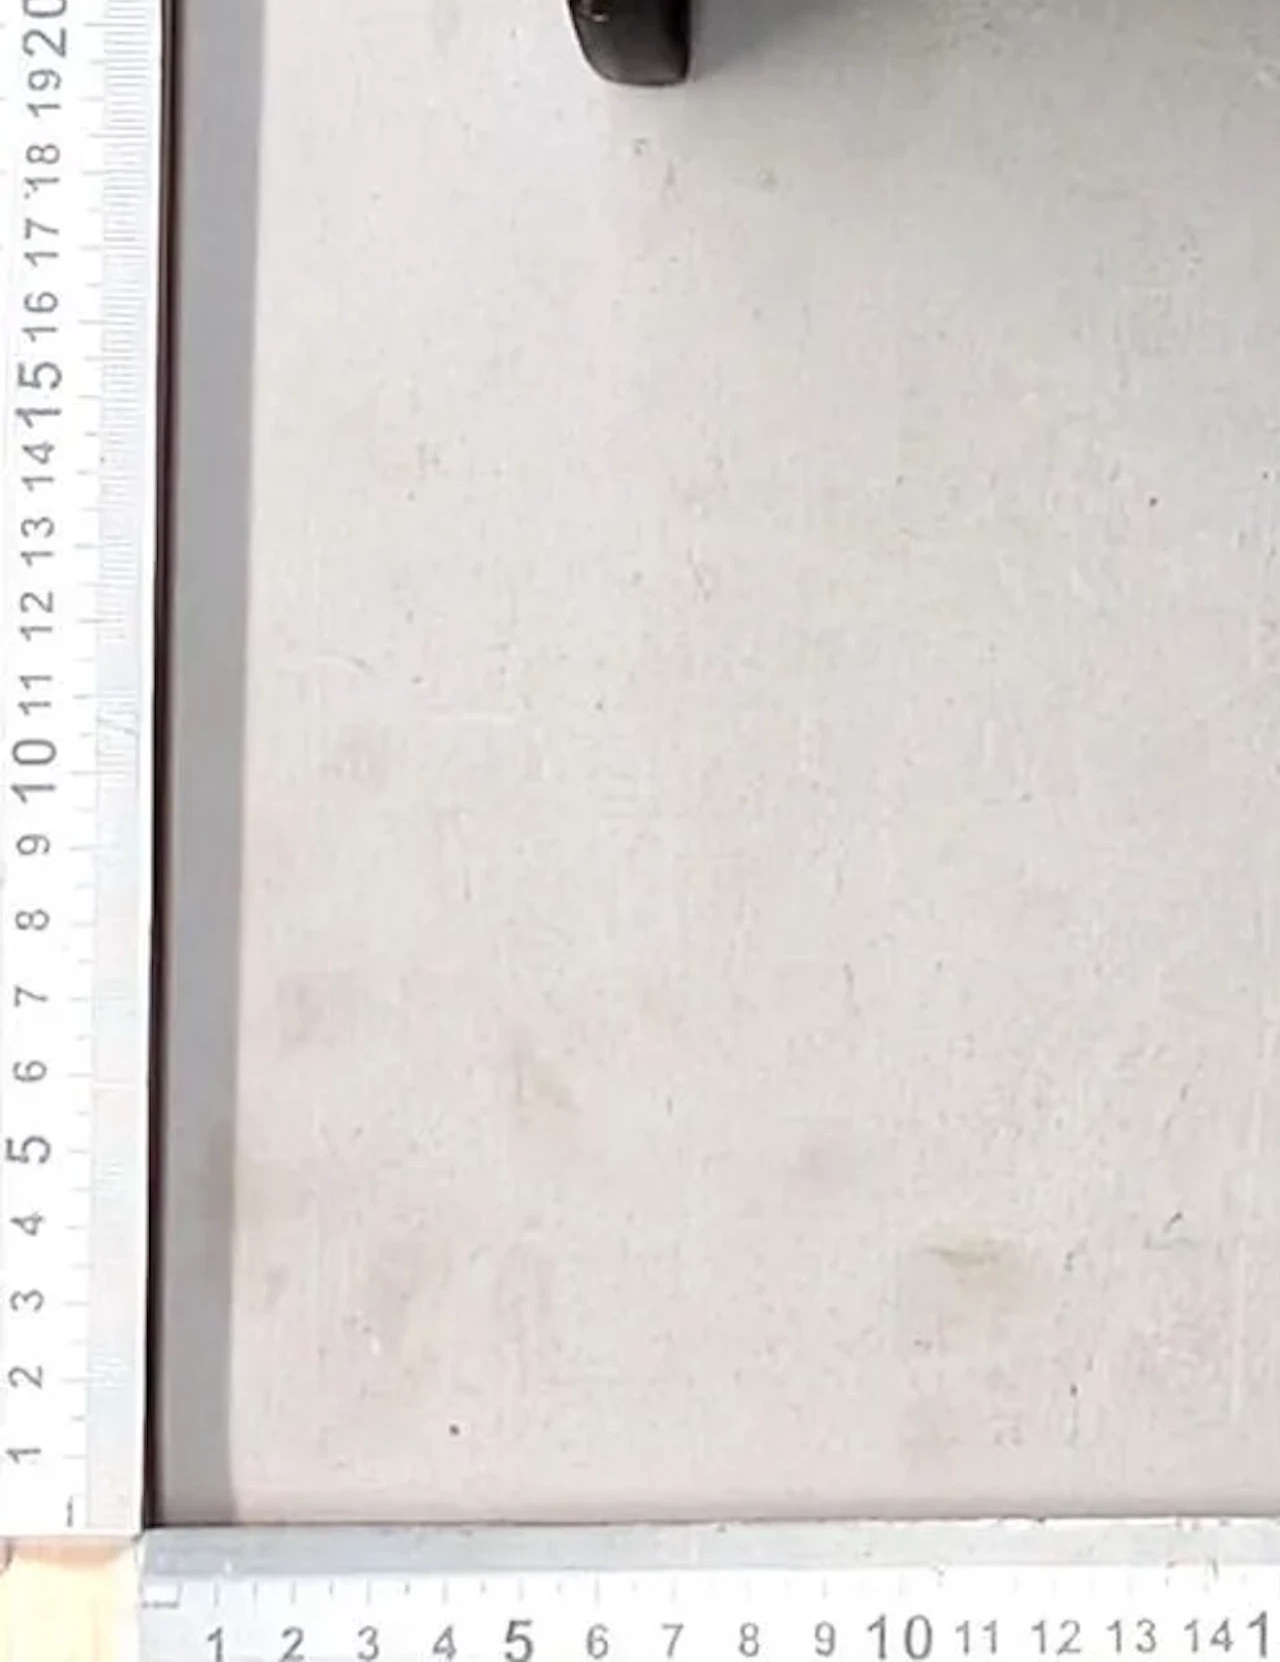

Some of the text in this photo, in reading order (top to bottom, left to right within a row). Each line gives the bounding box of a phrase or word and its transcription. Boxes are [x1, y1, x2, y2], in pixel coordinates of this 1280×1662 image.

[25, 67, 63, 119] 19
[23, 142, 62, 194] 18
[22, 216, 61, 269] 17
[20, 290, 60, 344] 16
[13, 360, 64, 430] 15
[20, 440, 56, 493] 14
[19, 515, 56, 569] 13
[17, 590, 55, 643] 12
[16, 674, 54, 717] 11
[9, 737, 58, 805] 10
[14, 832, 52, 857] 9
[13, 907, 51, 932] 8
[12, 984, 49, 1009] 7
[11, 1059, 49, 1084] 6
[4, 1134, 53, 1166] 5
[9, 1210, 46, 1238] 4
[8, 1288, 45, 1314] 3
[6, 1364, 45, 1390] 2
[4, 1446, 43, 1465] 1
[206, 1626, 224, 1662] 1
[278, 1625, 305, 1662] 2
[356, 1624, 381, 1662] 3
[431, 1623, 458, 1662] 4
[503, 1617, 536, 1662] 5
[584, 1622, 610, 1661] 6
[660, 1622, 685, 1660] 7
[737, 1621, 762, 1659] 8
[813, 1620, 837, 1659] 9
[865, 1612, 934, 1662] 10
[954, 1619, 998, 1657] 11
[1030, 1618, 1083, 1657] 12
[1105, 1616, 1158, 1655] 13
[1183, 1616, 1235, 1655] 14
